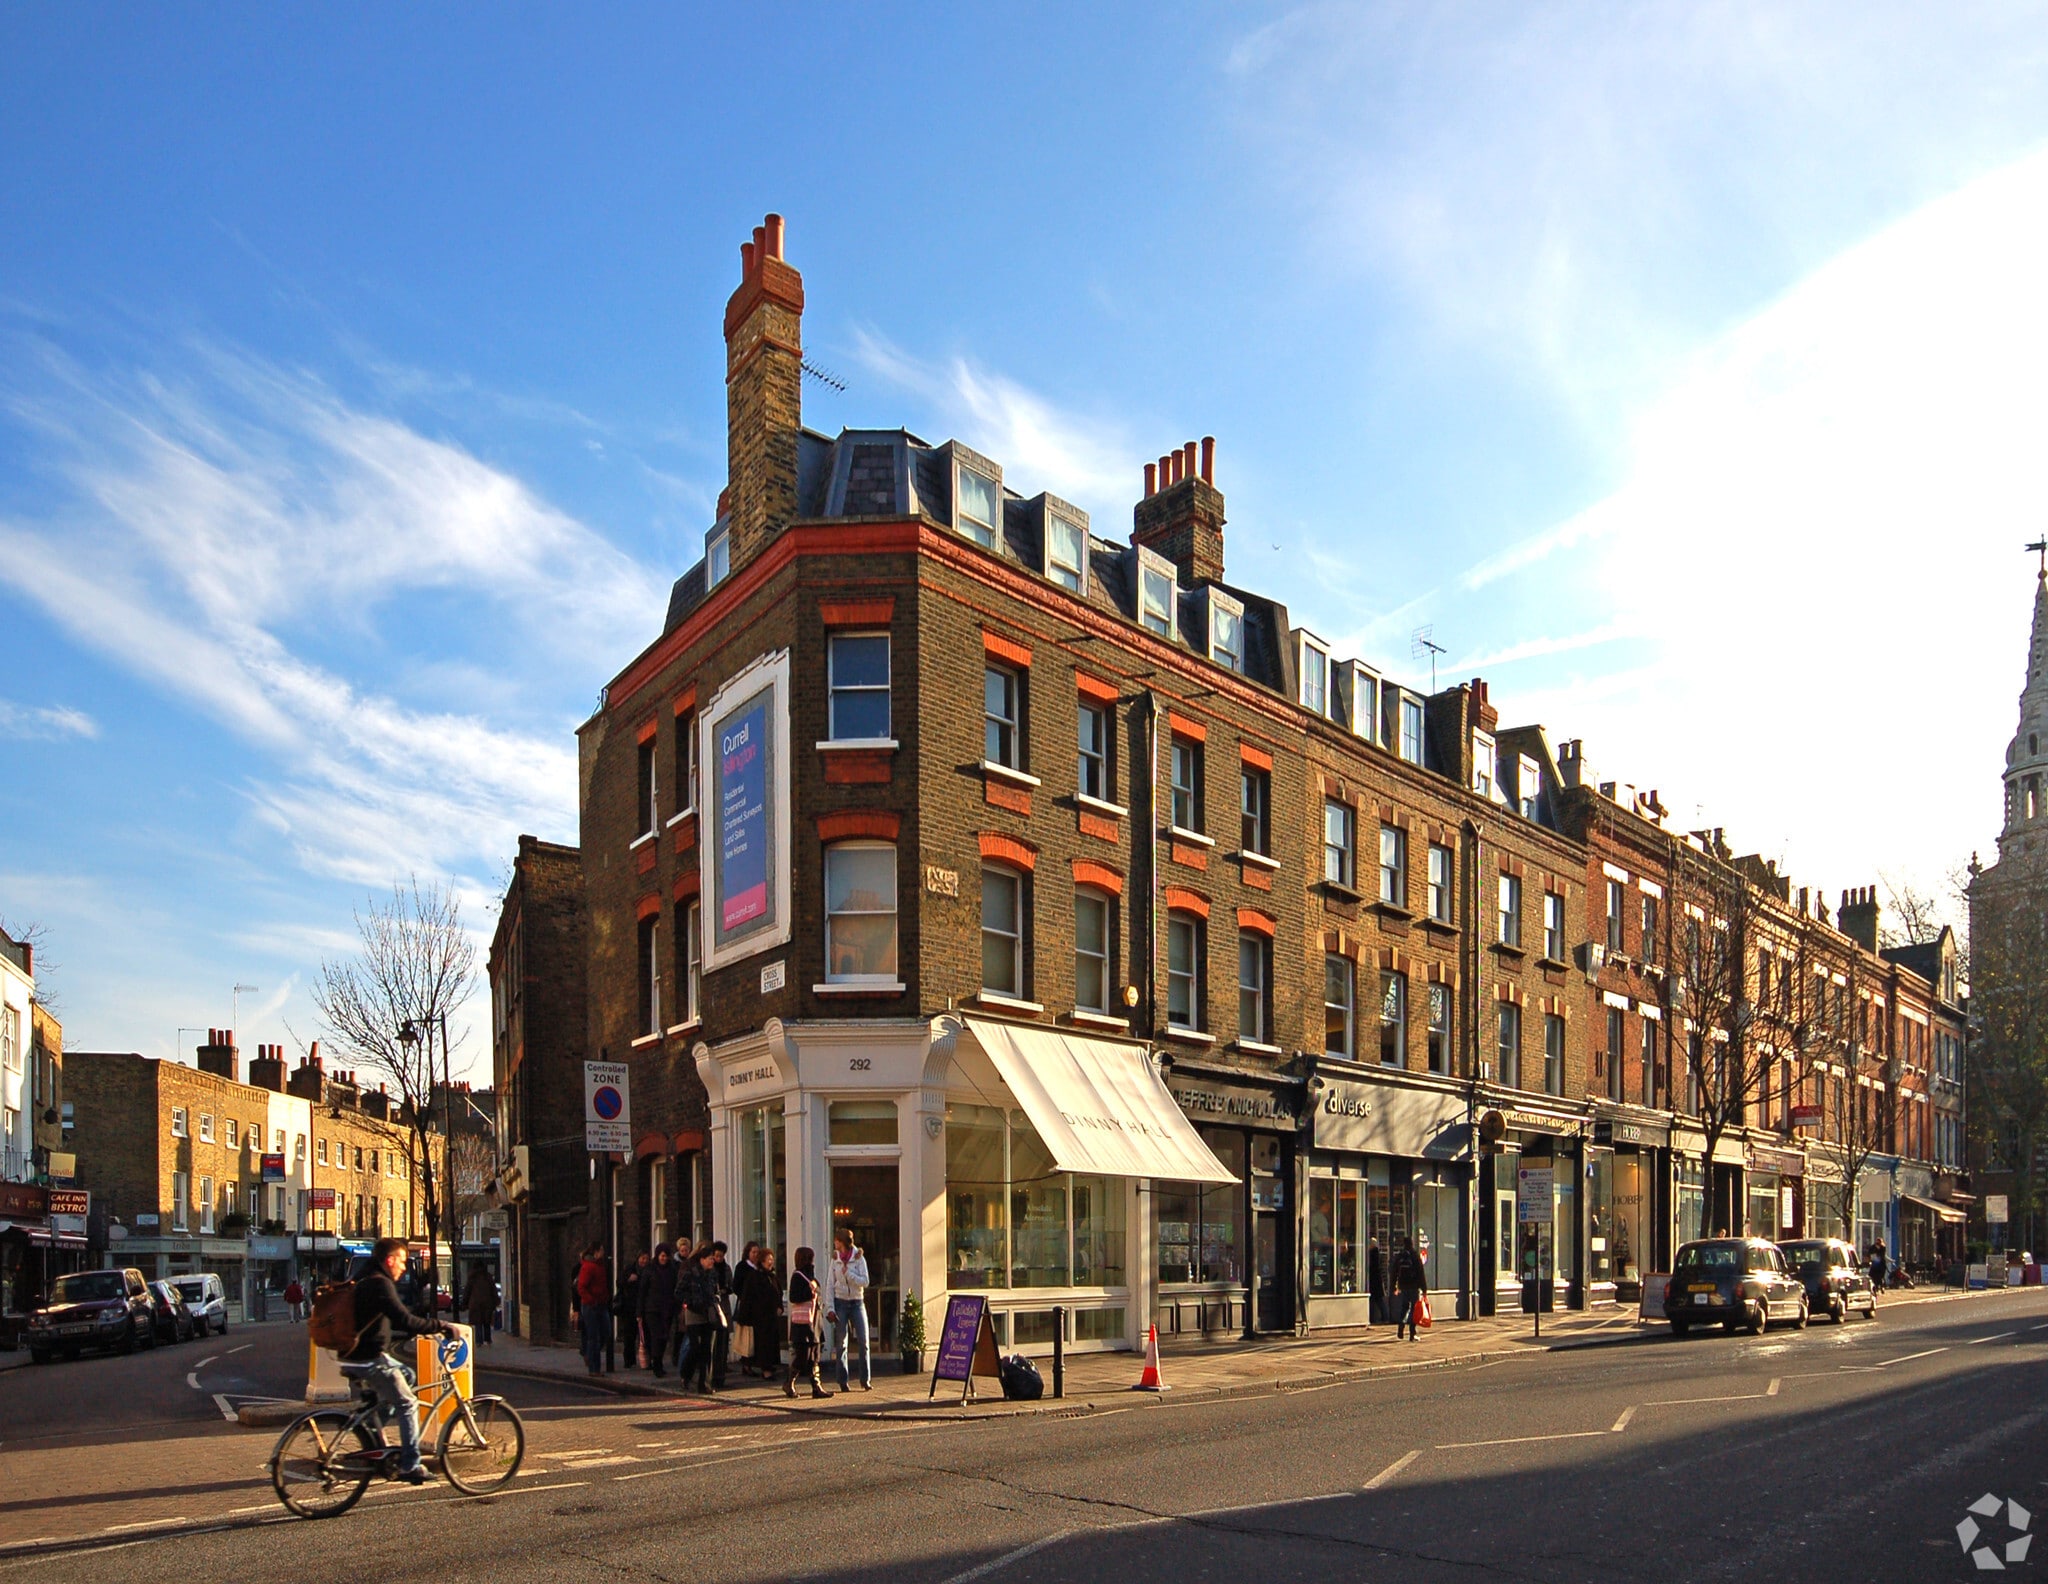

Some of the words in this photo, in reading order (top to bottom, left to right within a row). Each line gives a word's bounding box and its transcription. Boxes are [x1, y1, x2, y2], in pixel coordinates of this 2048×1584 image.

[723, 722, 749, 755] Currell
[763, 968, 778, 981] CROSS
[763, 978, 780, 992] STREET
[587, 1063, 627, 1074] Controlled
[850, 1058, 871, 1071] 292
[593, 1074, 621, 1085] ZONE
[730, 1071, 753, 1086] DINNY
[755, 1066, 775, 1080] HALL
[1328, 1088, 1372, 1118] diverse
[1060, 1111, 1123, 1132] DINNY
[1128, 1123, 1172, 1139] HALL
[50, 1193, 71, 1202] CAFÉ
[72, 1194, 87, 1203] INN
[50, 1203, 87, 1213] BISTRO
